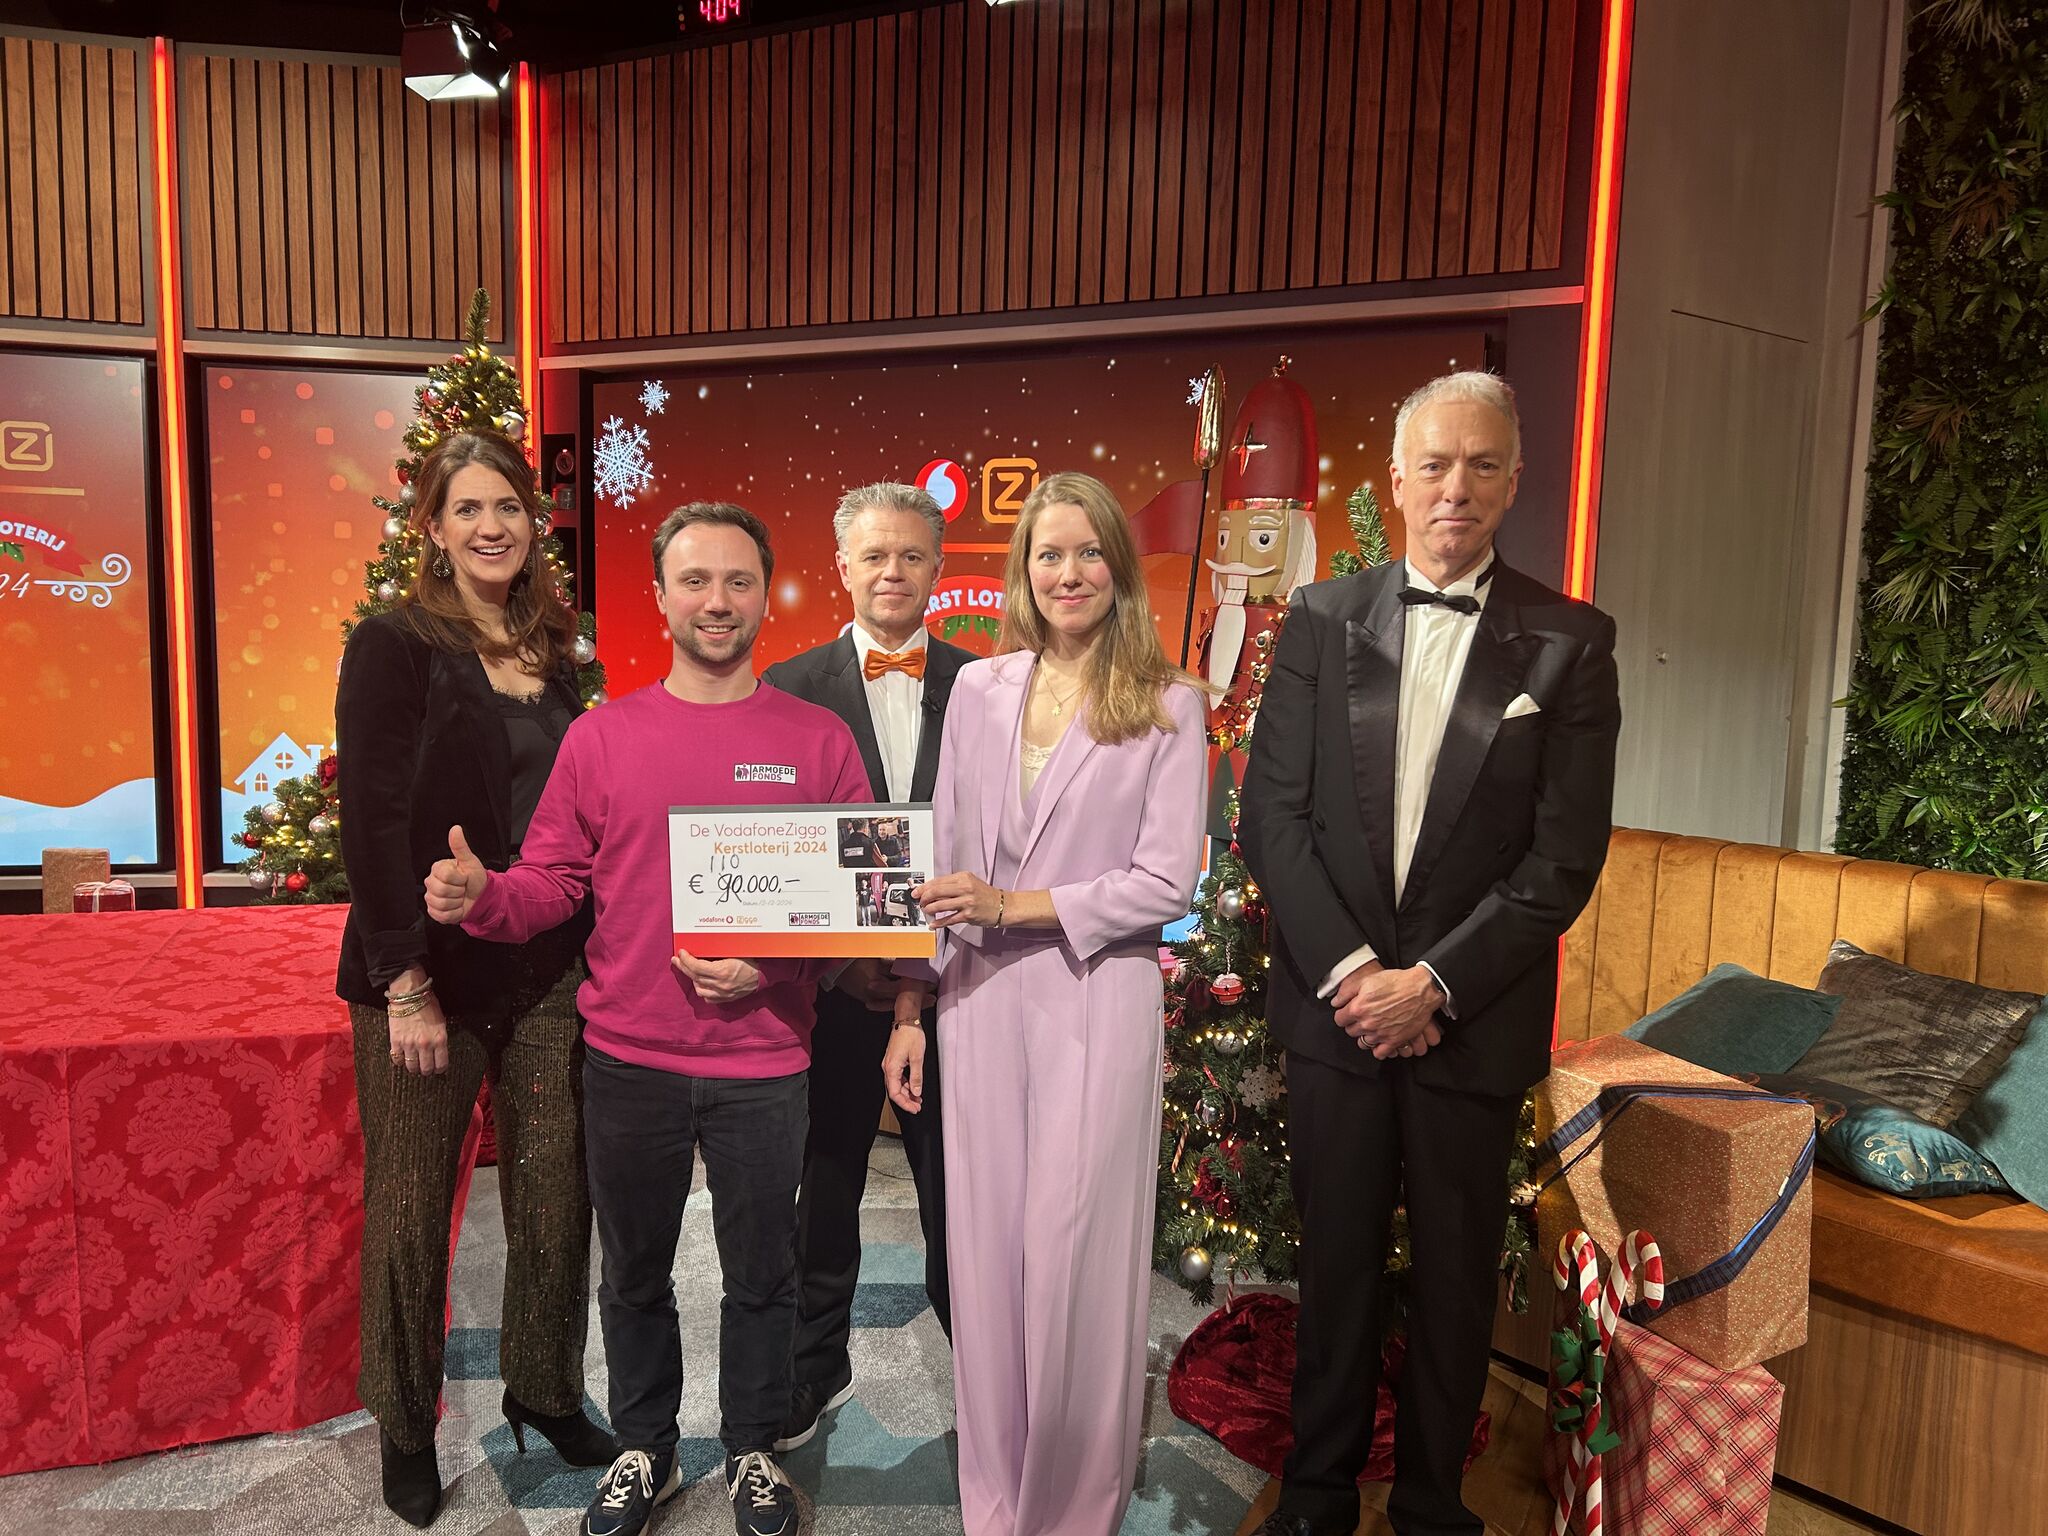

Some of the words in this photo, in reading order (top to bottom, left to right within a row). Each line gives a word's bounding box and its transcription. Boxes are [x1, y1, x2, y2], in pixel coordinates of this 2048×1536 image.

[967, 588, 1008, 610] LOT
[752, 765, 795, 775] ARMOEDE
[752, 773, 782, 781] FONDS
[690, 823, 710, 838] De
[714, 822, 827, 839] VodafoneZiggo
[714, 841, 789, 856] Kerstloterij
[793, 841, 828, 853] 2024
[688, 874, 704, 894] €
[699, 915, 725, 923] vodafone
